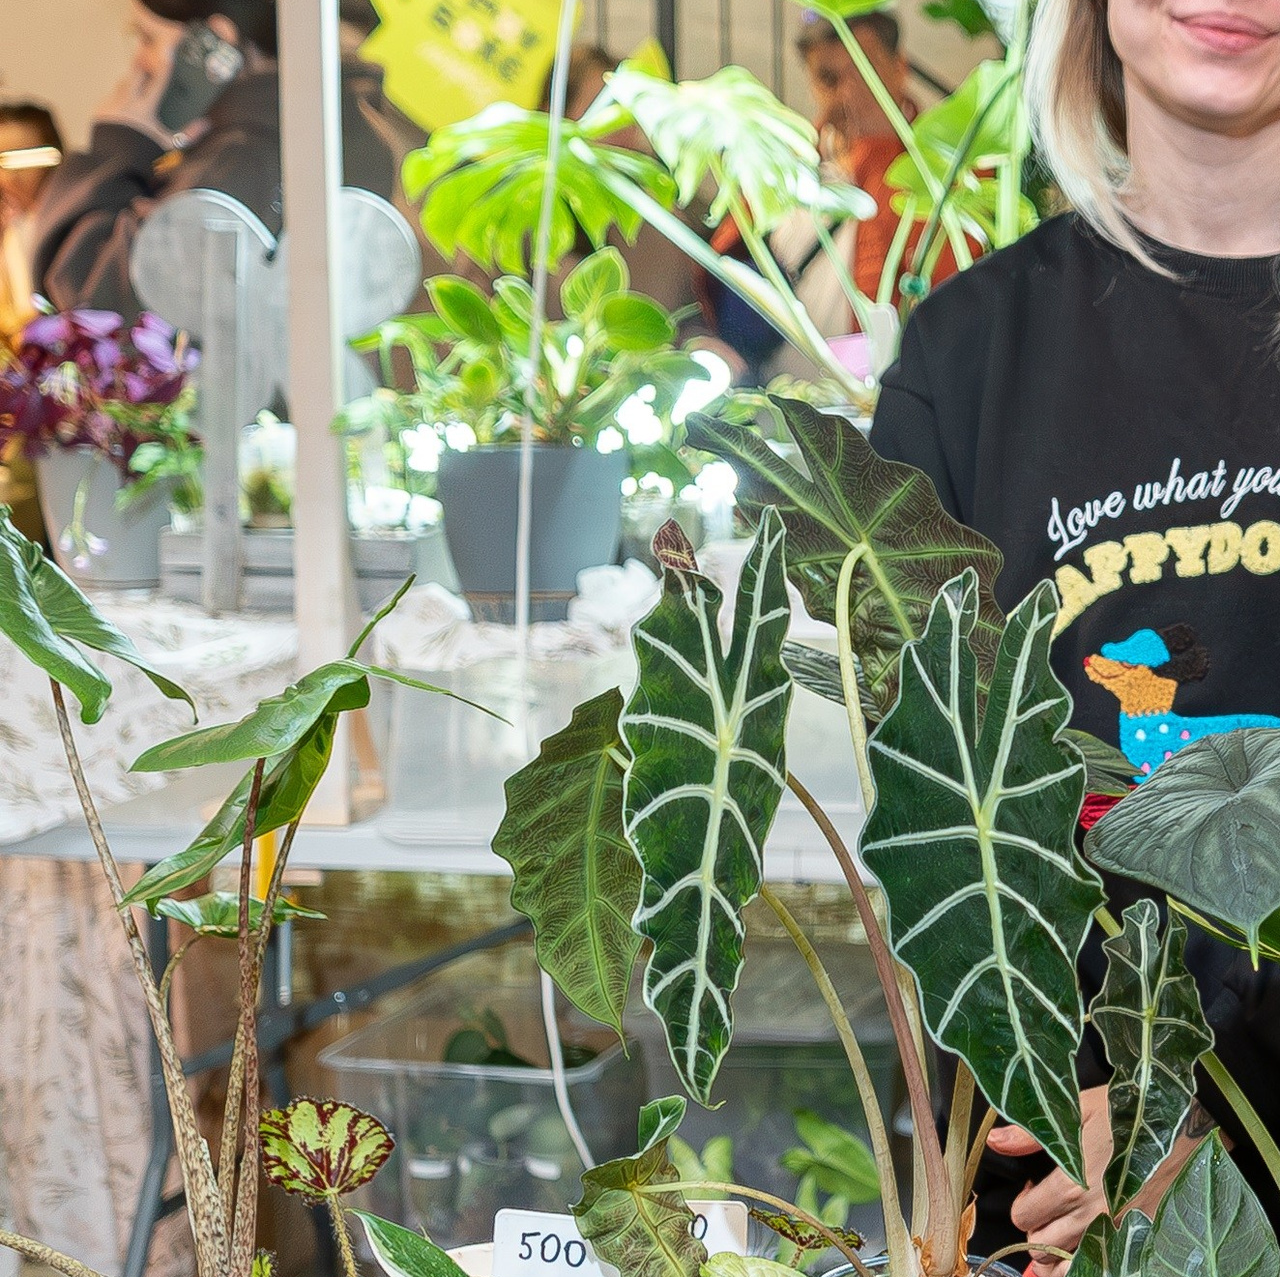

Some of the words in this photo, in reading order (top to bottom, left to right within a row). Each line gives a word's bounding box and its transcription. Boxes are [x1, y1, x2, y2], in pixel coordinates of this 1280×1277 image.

[1047, 491, 1126, 561] Love
[1133, 457, 1227, 511] what
[518, 1231, 587, 1268] 500
